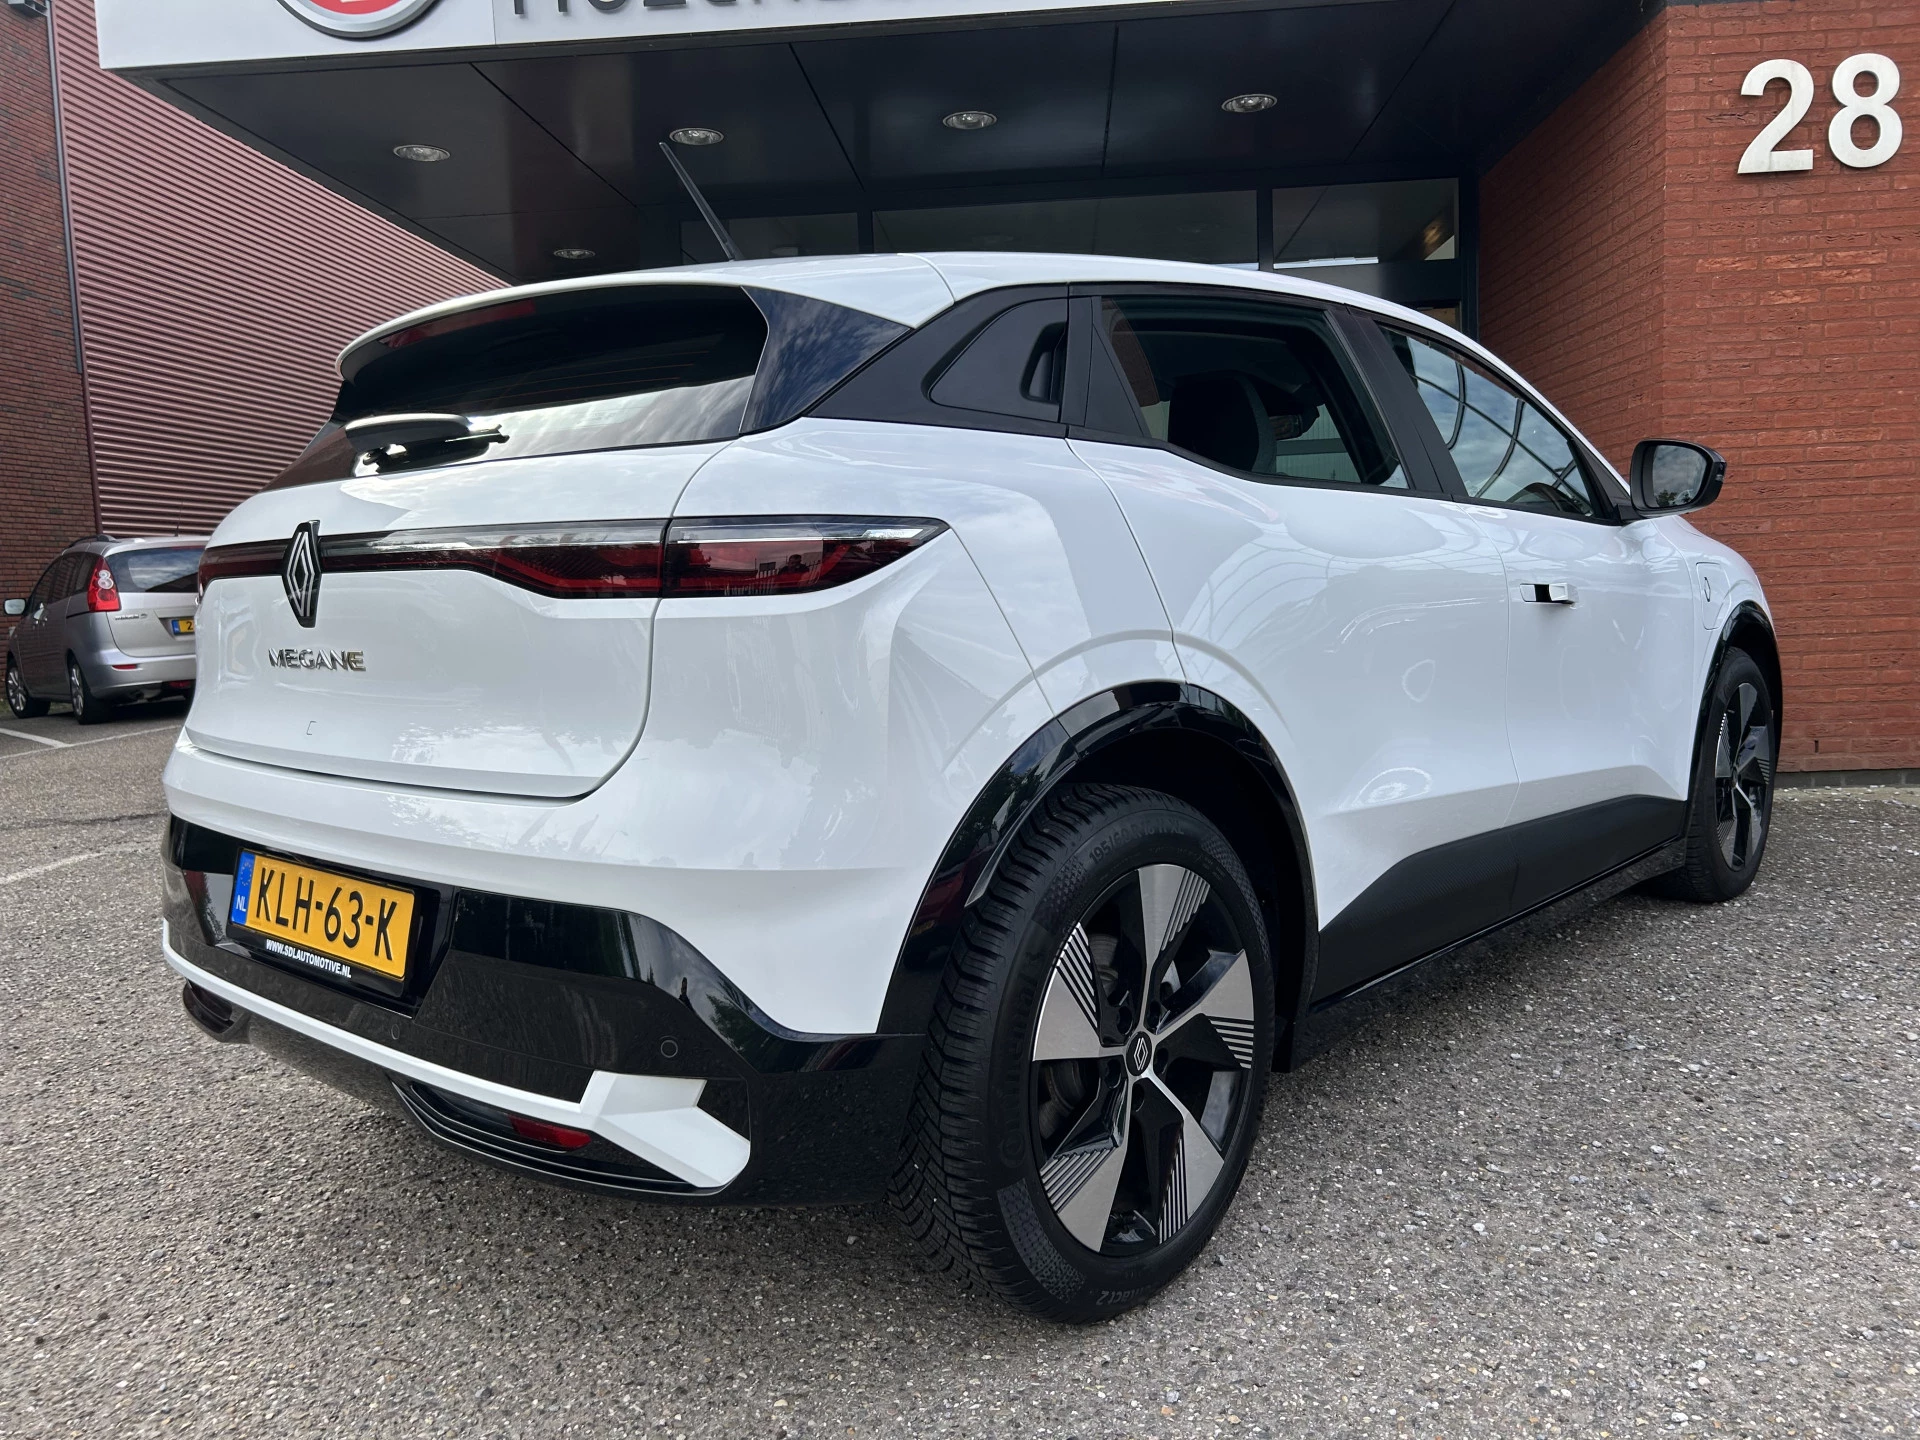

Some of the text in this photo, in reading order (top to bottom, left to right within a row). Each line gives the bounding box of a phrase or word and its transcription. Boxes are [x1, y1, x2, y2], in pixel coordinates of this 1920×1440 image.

[1737, 53, 1902, 173] 28
[268, 648, 366, 671] MEGANE
[235, 894, 247, 912] NL
[255, 867, 398, 961] KLH-63-K
[265, 939, 352, 978] WWW.SDLAUTOMOTIVE.NL
